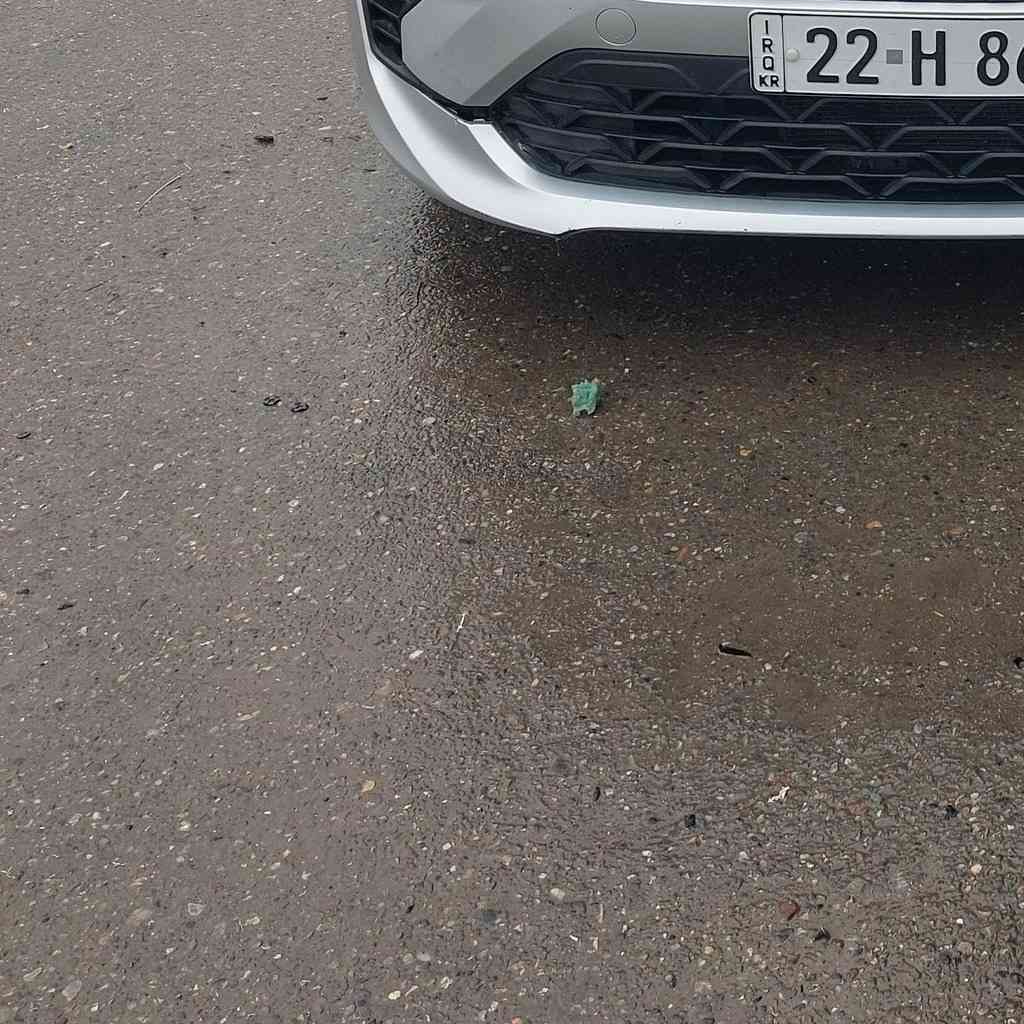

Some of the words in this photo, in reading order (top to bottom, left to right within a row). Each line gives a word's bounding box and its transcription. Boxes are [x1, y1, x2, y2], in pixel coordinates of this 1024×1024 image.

[806, 27, 879, 84] 22
[911, 30, 947, 86] H
[759, 74, 780, 88] KR
